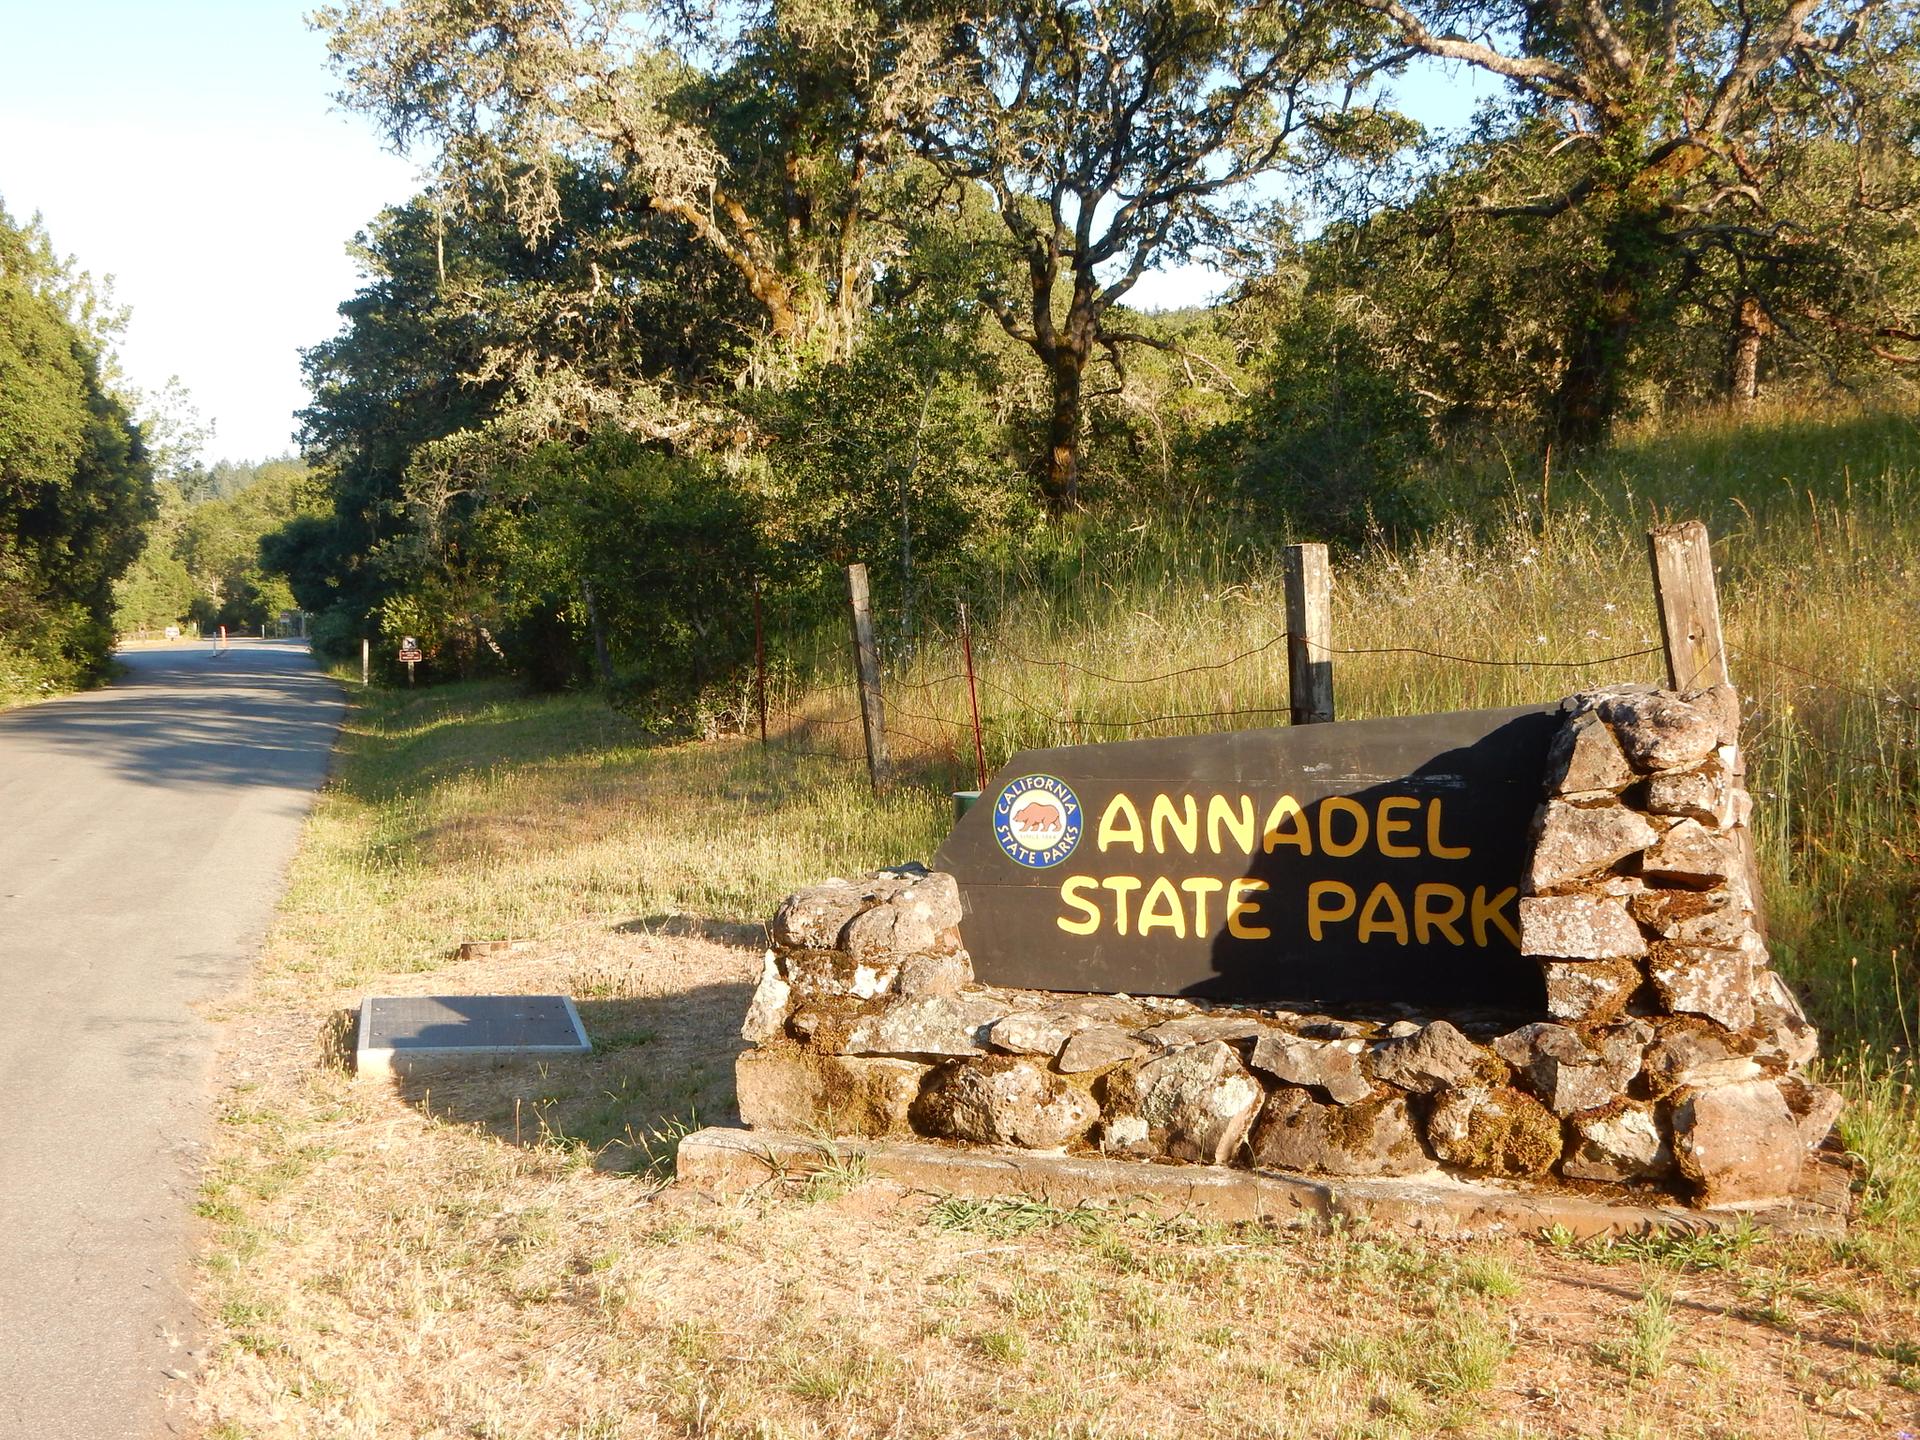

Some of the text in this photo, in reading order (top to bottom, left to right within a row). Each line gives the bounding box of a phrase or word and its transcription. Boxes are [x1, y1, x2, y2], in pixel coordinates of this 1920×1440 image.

[998, 776, 1078, 815] CALIFORNIA
[997, 825, 1079, 864] STATE PARKS
[1097, 792, 1471, 860] ANNADEL
[1056, 875, 1521, 950] STATE PARK
